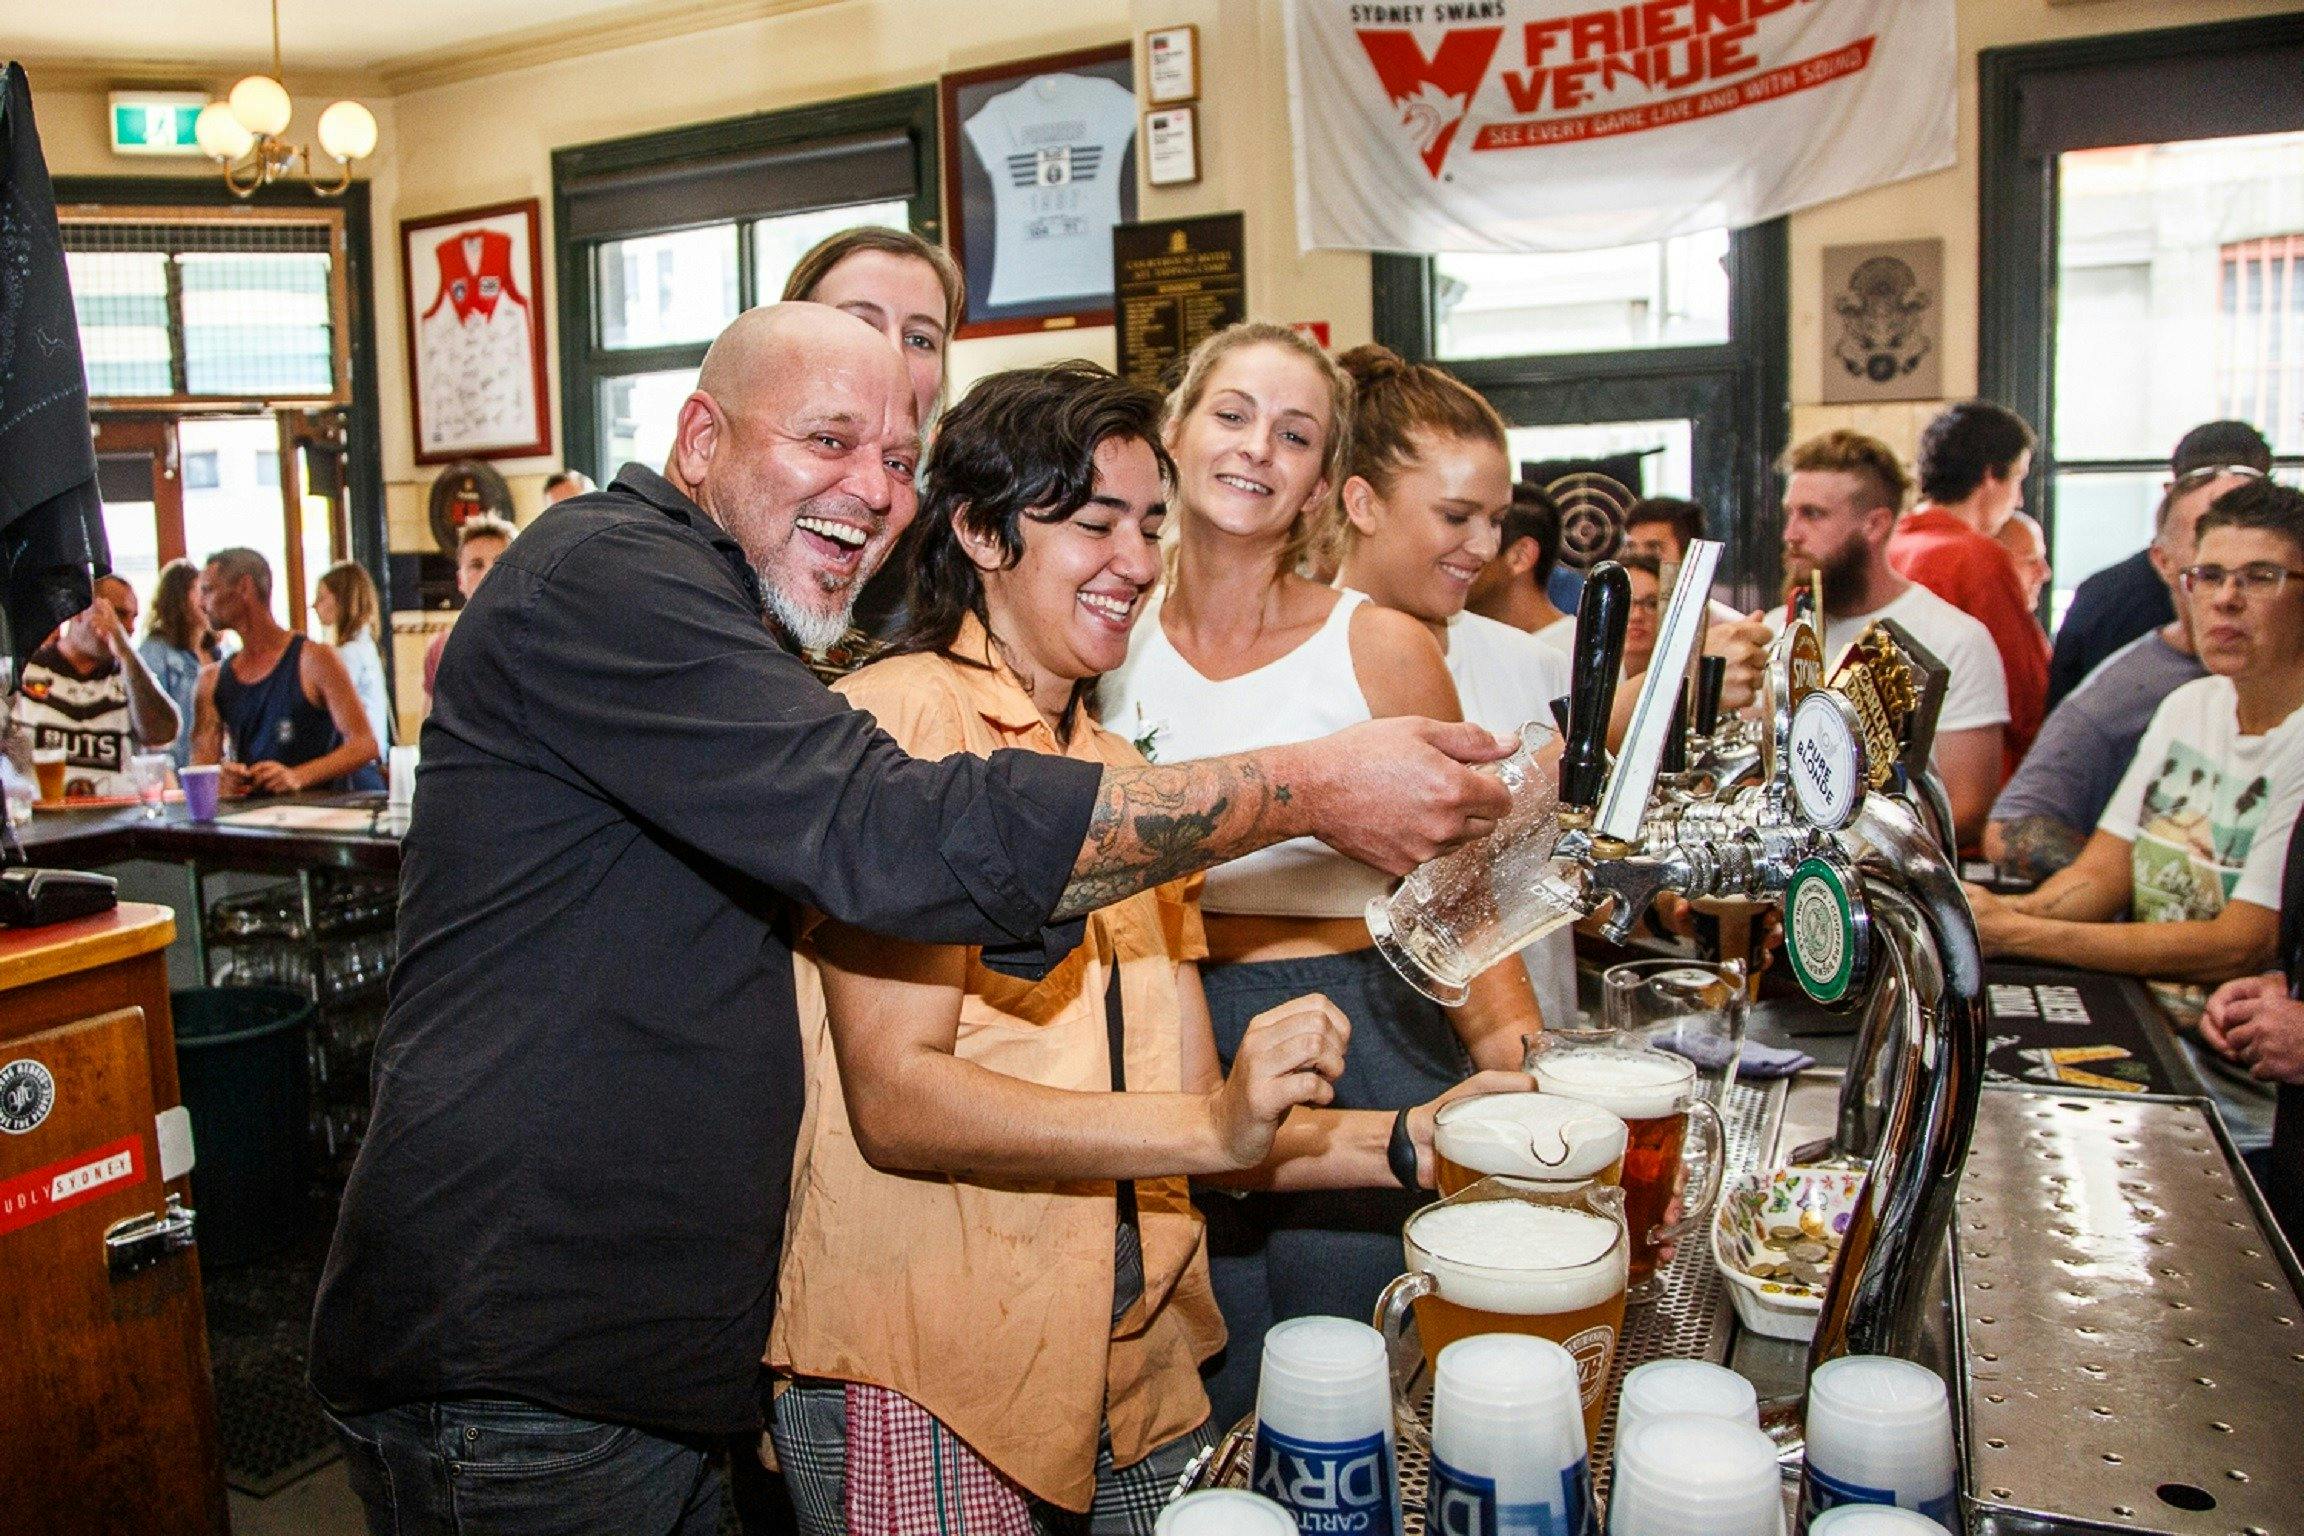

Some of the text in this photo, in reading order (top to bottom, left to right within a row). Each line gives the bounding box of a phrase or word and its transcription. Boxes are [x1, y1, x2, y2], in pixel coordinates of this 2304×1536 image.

[1352, 0, 1506, 23] SYDNEY SWANS
[1490, 48, 1862, 145] SEE EVERY GAME LIVE AND WITH SOUND
[1503, 23, 1757, 113] VENUE
[1796, 740, 1835, 805] BLONDE
[1807, 738, 1832, 783] PURE
[56, 1158, 126, 1194] SYDNEY
[1256, 1447, 1383, 1509] DRY
